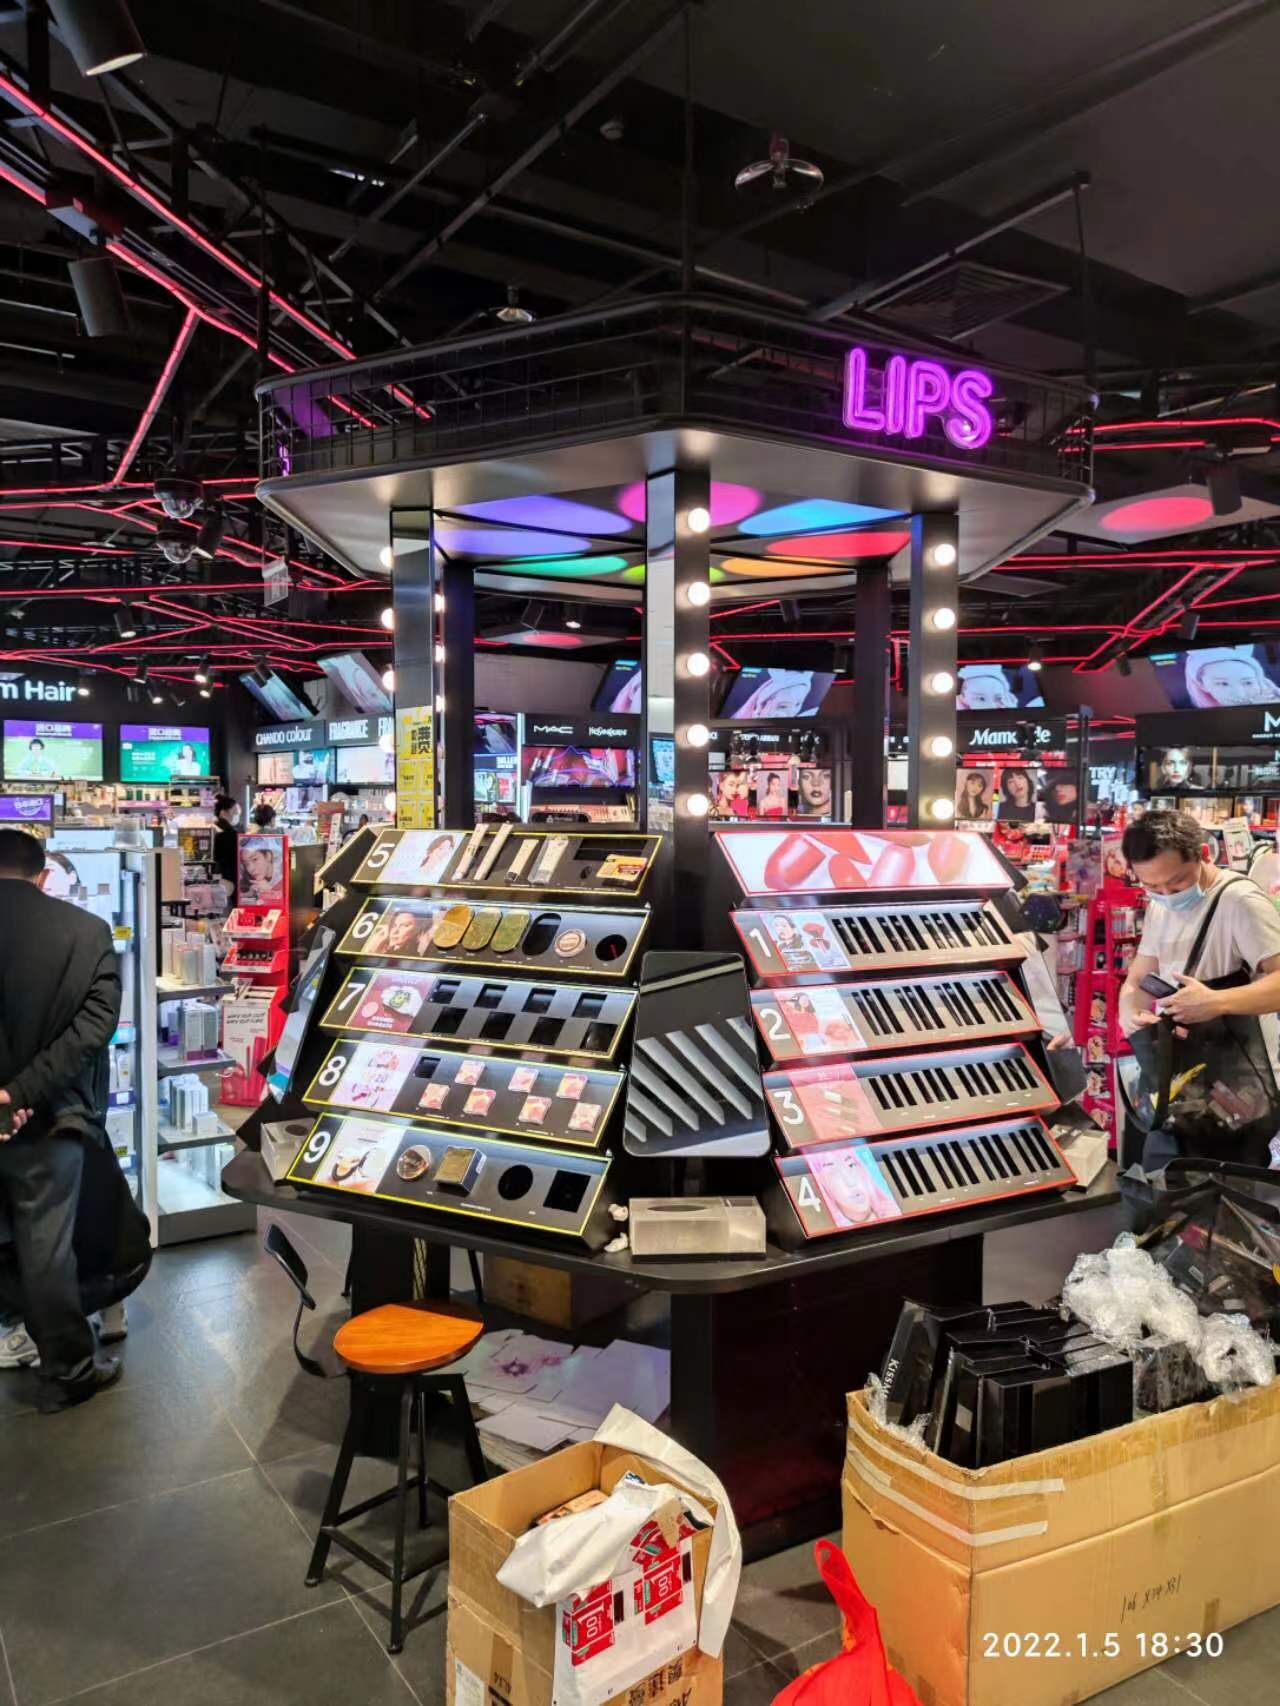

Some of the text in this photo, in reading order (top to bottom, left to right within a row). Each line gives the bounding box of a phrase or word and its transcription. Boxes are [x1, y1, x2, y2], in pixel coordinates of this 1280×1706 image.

[842, 347, 993, 449] LIPS
[24, 679, 76, 702] Hair
[367, 843, 396, 868] 5
[352, 912, 379, 939] 6
[749, 928, 772, 958] 1
[337, 983, 367, 1011] 7
[759, 1008, 791, 1040] 2
[318, 1056, 347, 1087] 8
[774, 1091, 805, 1125] 3
[303, 1131, 332, 1164] 9
[798, 1177, 822, 1213] 4
